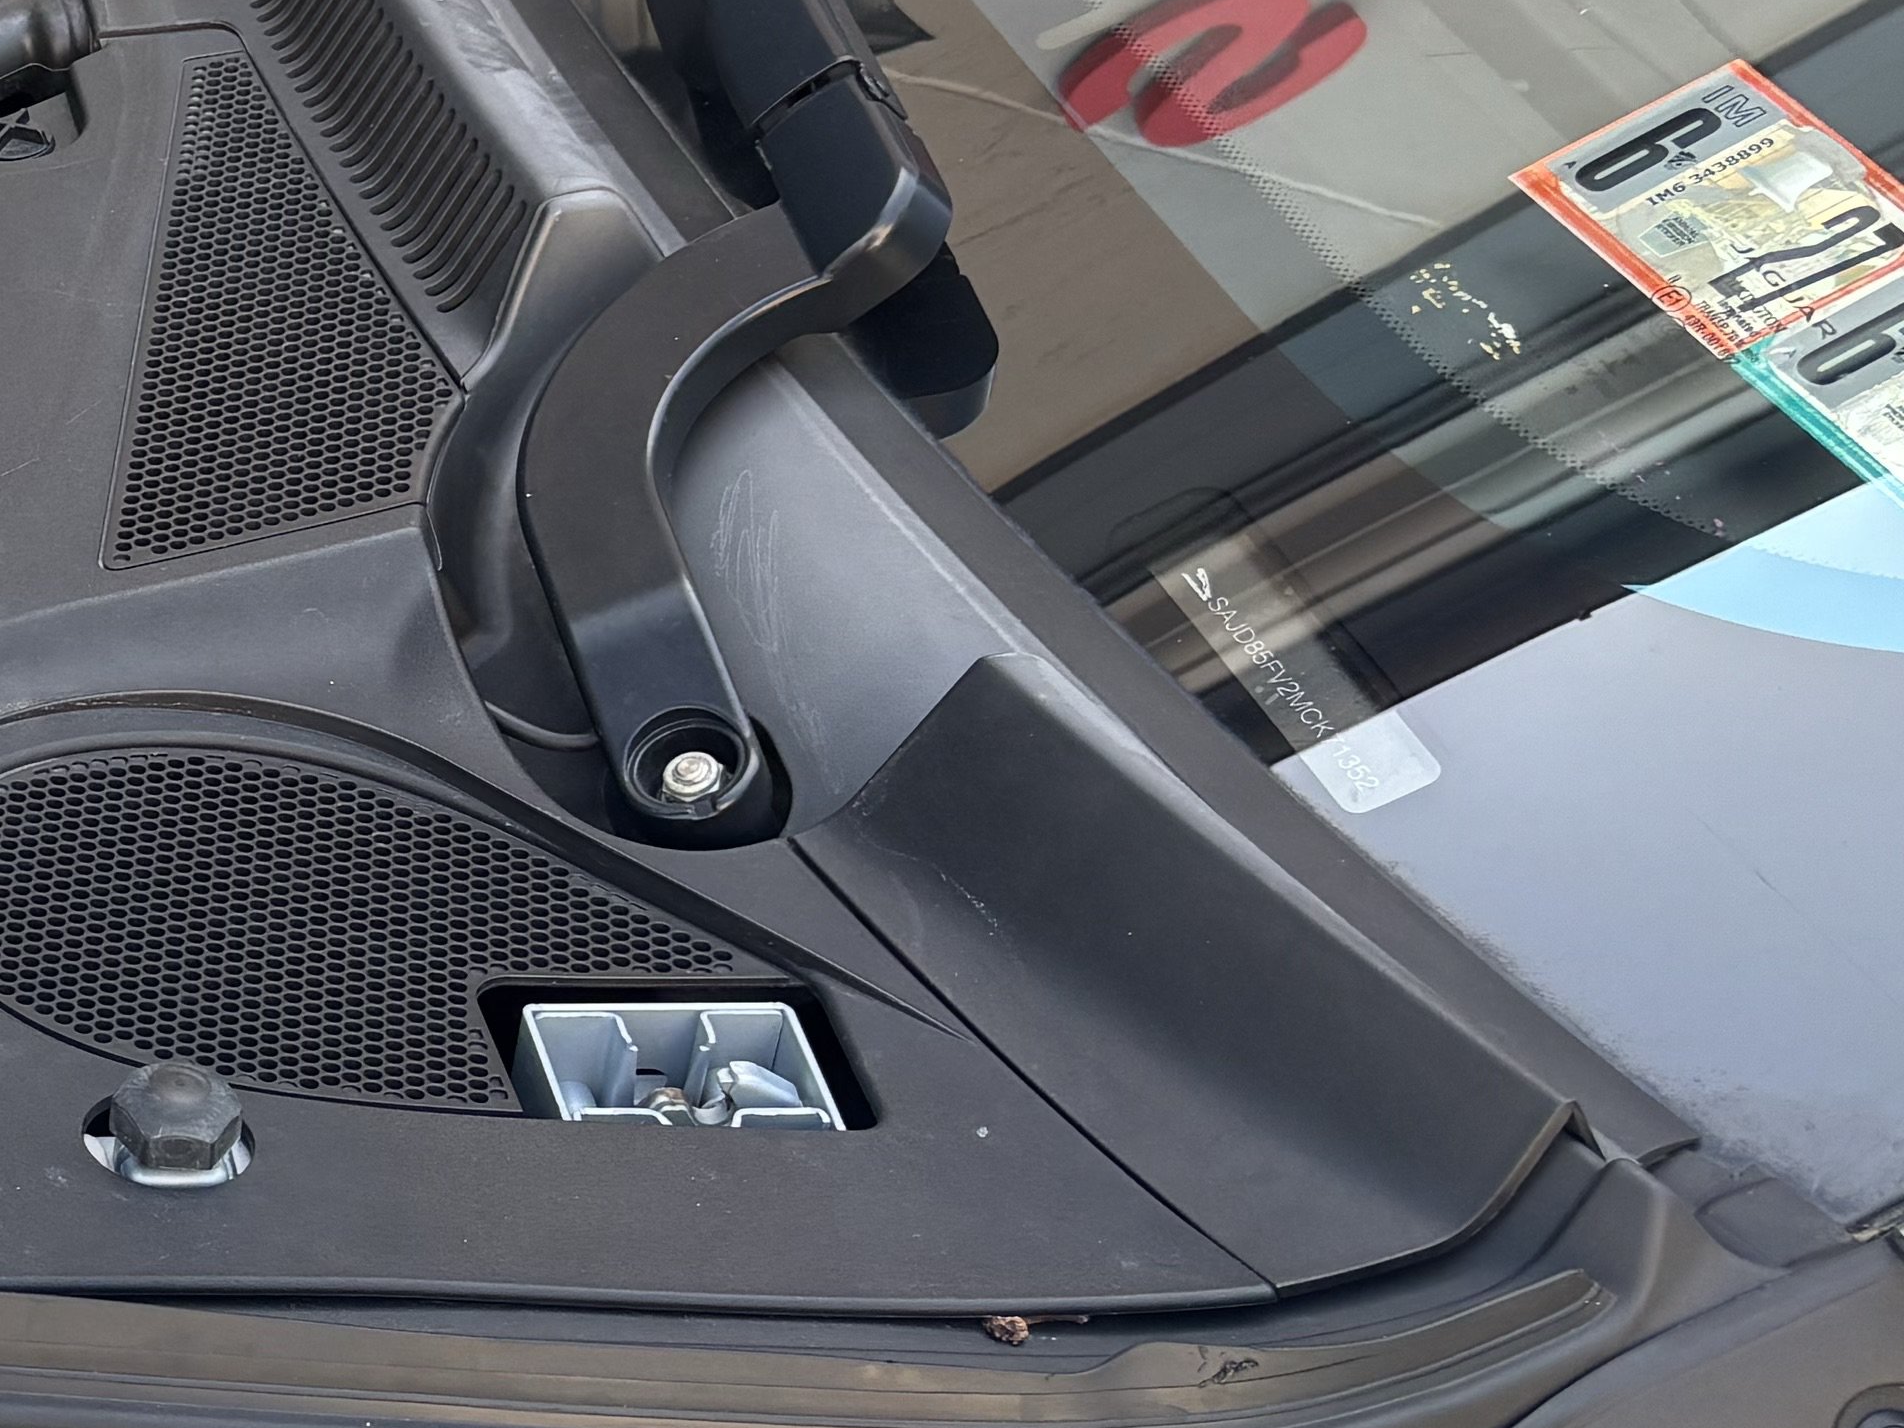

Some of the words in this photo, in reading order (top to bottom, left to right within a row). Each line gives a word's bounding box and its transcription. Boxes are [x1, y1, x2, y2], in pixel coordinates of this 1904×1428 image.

[1701, 84, 1767, 128] IM
[1574, 107, 1722, 192] 6
[1688, 136, 1776, 184] 3438899
